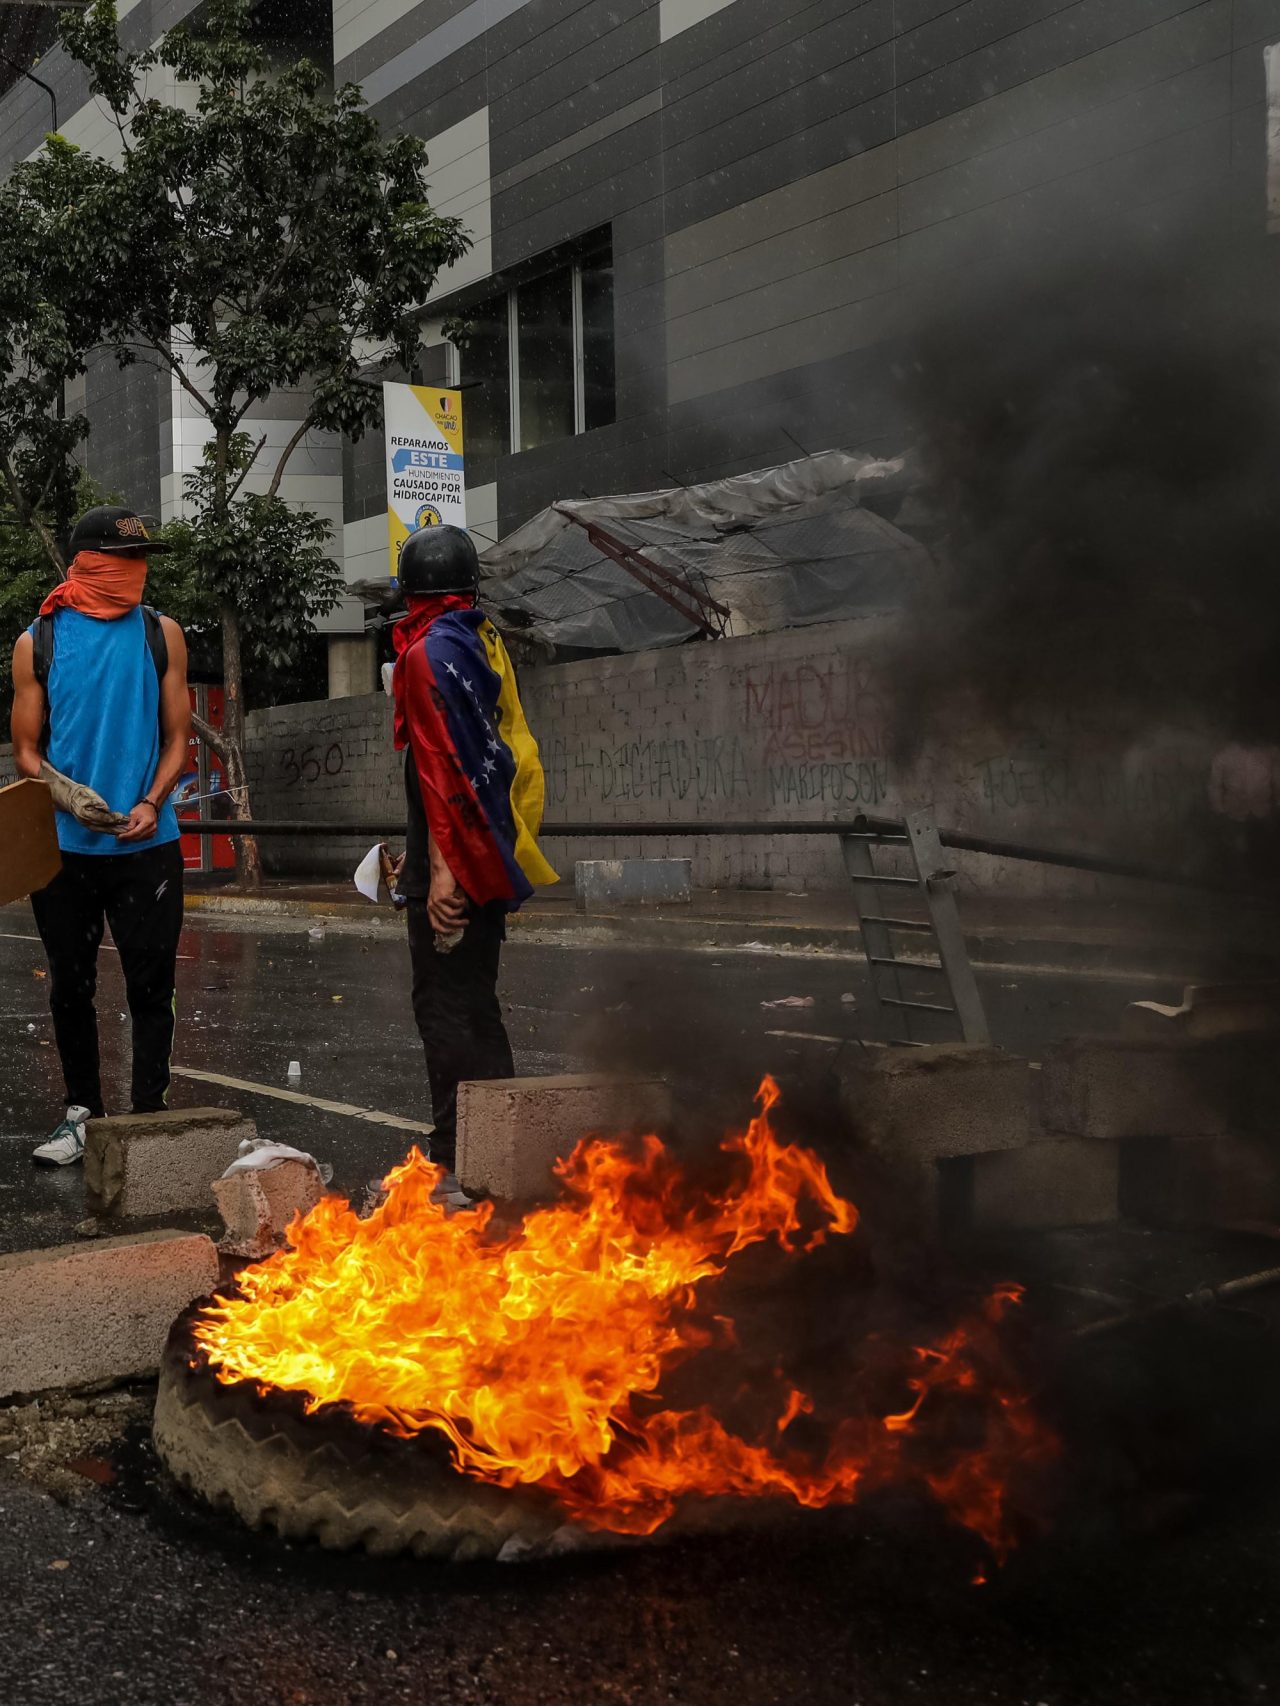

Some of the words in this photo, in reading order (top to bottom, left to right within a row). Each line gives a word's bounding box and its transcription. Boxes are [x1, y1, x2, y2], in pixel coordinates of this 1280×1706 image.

[435, 413, 458, 421] CHACAO
[391, 436, 449, 451] REPARAMOS
[410, 452, 448, 468] ESTE
[408, 469, 461, 482] HUNDIMIENTO
[393, 478, 439, 492] CAUSADO
[441, 481, 461, 493] POR
[393, 490, 462, 504] HIDROCAPITAL
[280, 742, 344, 787] 350
